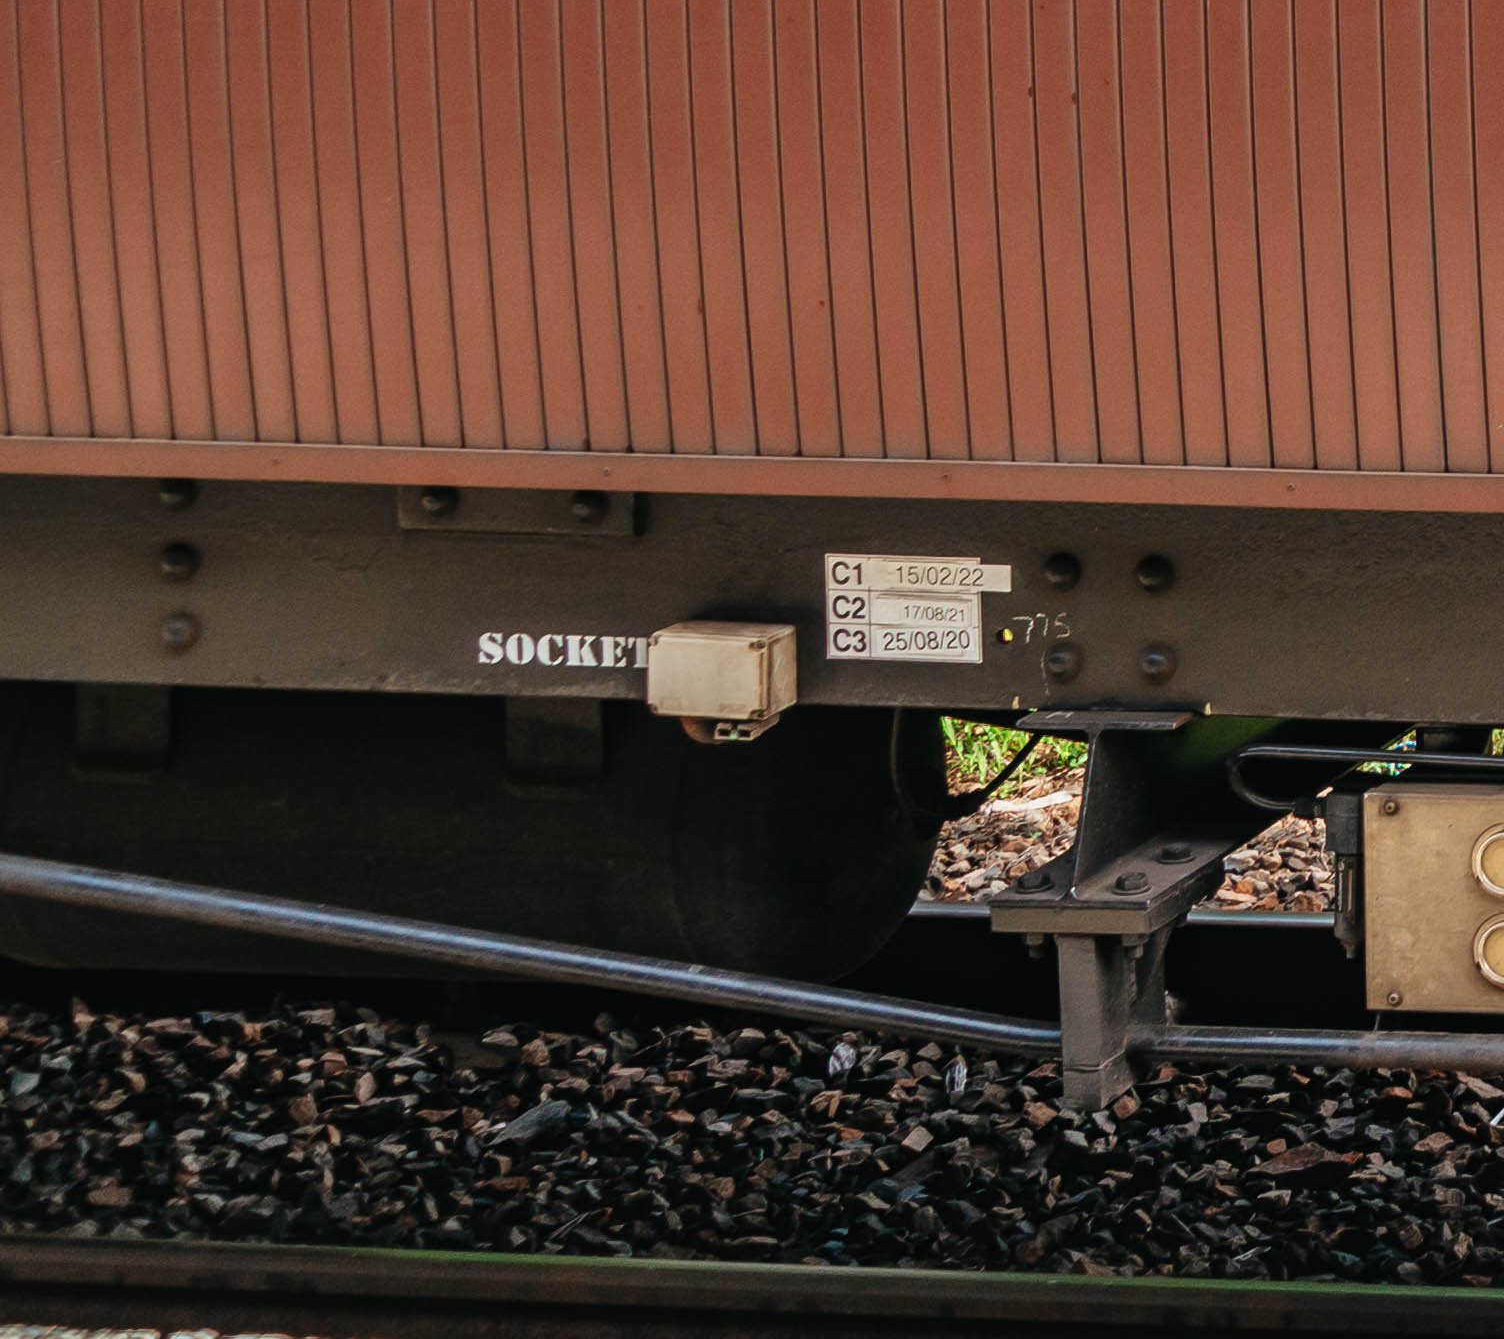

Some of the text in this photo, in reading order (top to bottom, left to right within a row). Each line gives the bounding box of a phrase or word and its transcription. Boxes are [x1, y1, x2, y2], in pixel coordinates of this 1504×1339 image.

[831, 561, 984, 587] C1 15/02/22
[831, 595, 966, 622] C2 17/08/21
[478, 631, 650, 669] SOCKET
[832, 628, 970, 653] C3 25/08/20
